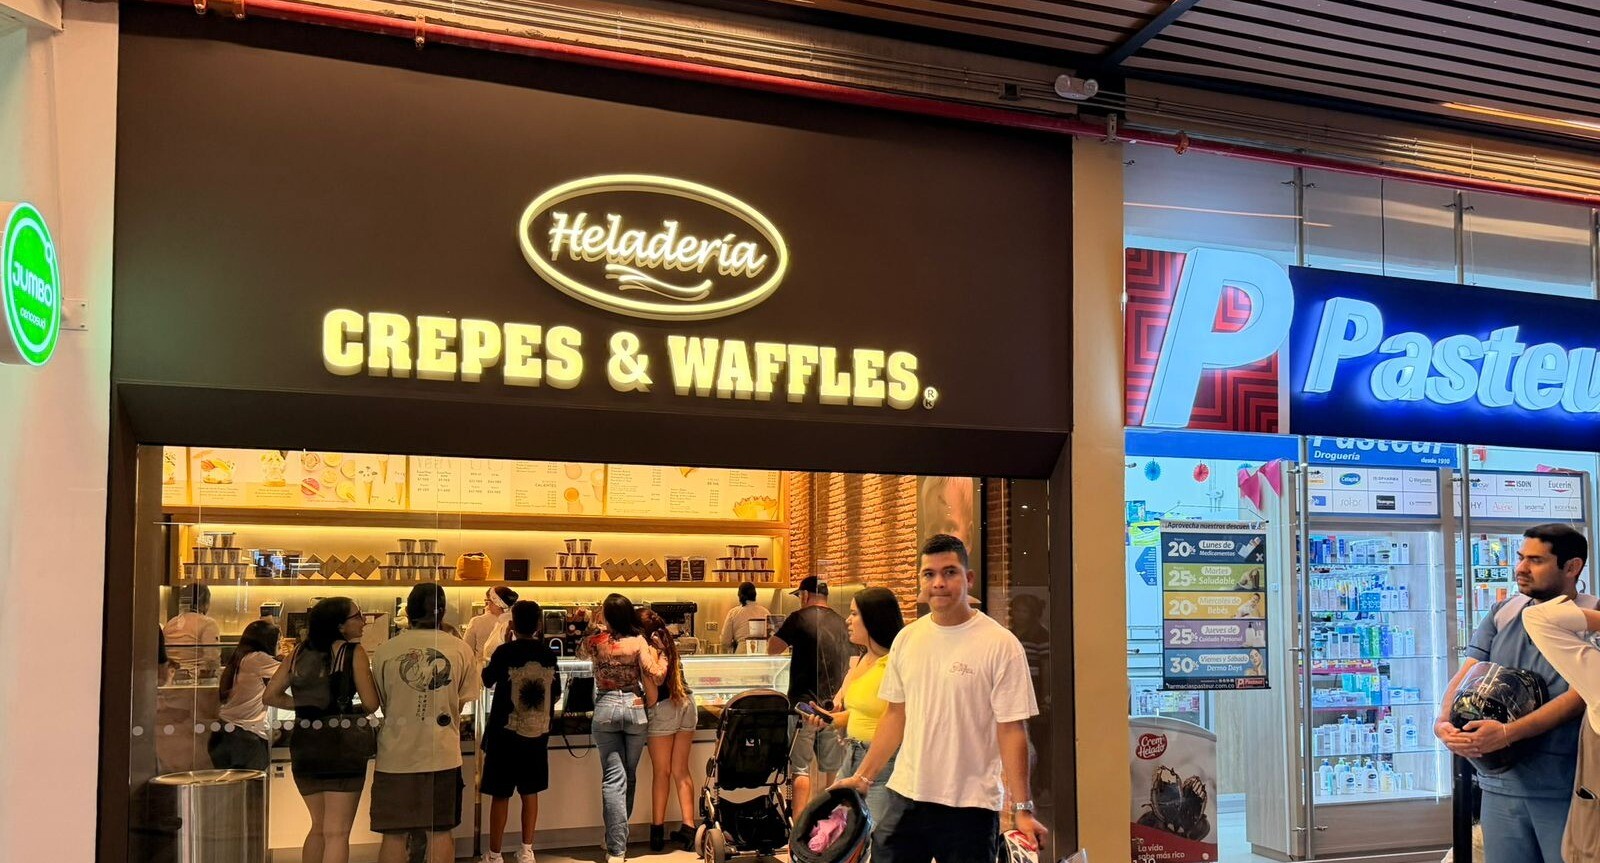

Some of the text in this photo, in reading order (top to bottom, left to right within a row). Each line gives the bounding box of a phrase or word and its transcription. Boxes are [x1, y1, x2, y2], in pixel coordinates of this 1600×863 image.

[549, 211, 768, 274] Heladería
[12, 261, 53, 307] JUMBO
[322, 308, 583, 389] CREPES
[607, 330, 653, 393] &
[667, 335, 919, 409] WAFFLES
[1314, 450, 1361, 461] Droguería
[1516, 480, 1532, 488] ISDIN
[1548, 481, 1572, 489] Eucerin
[1199, 576, 1235, 585] Saludable
[1228, 664, 1242, 672] Days
[1141, 735, 1163, 746] Crem
[1138, 745, 1165, 758] Helado
[1148, 843, 1164, 851] vida
